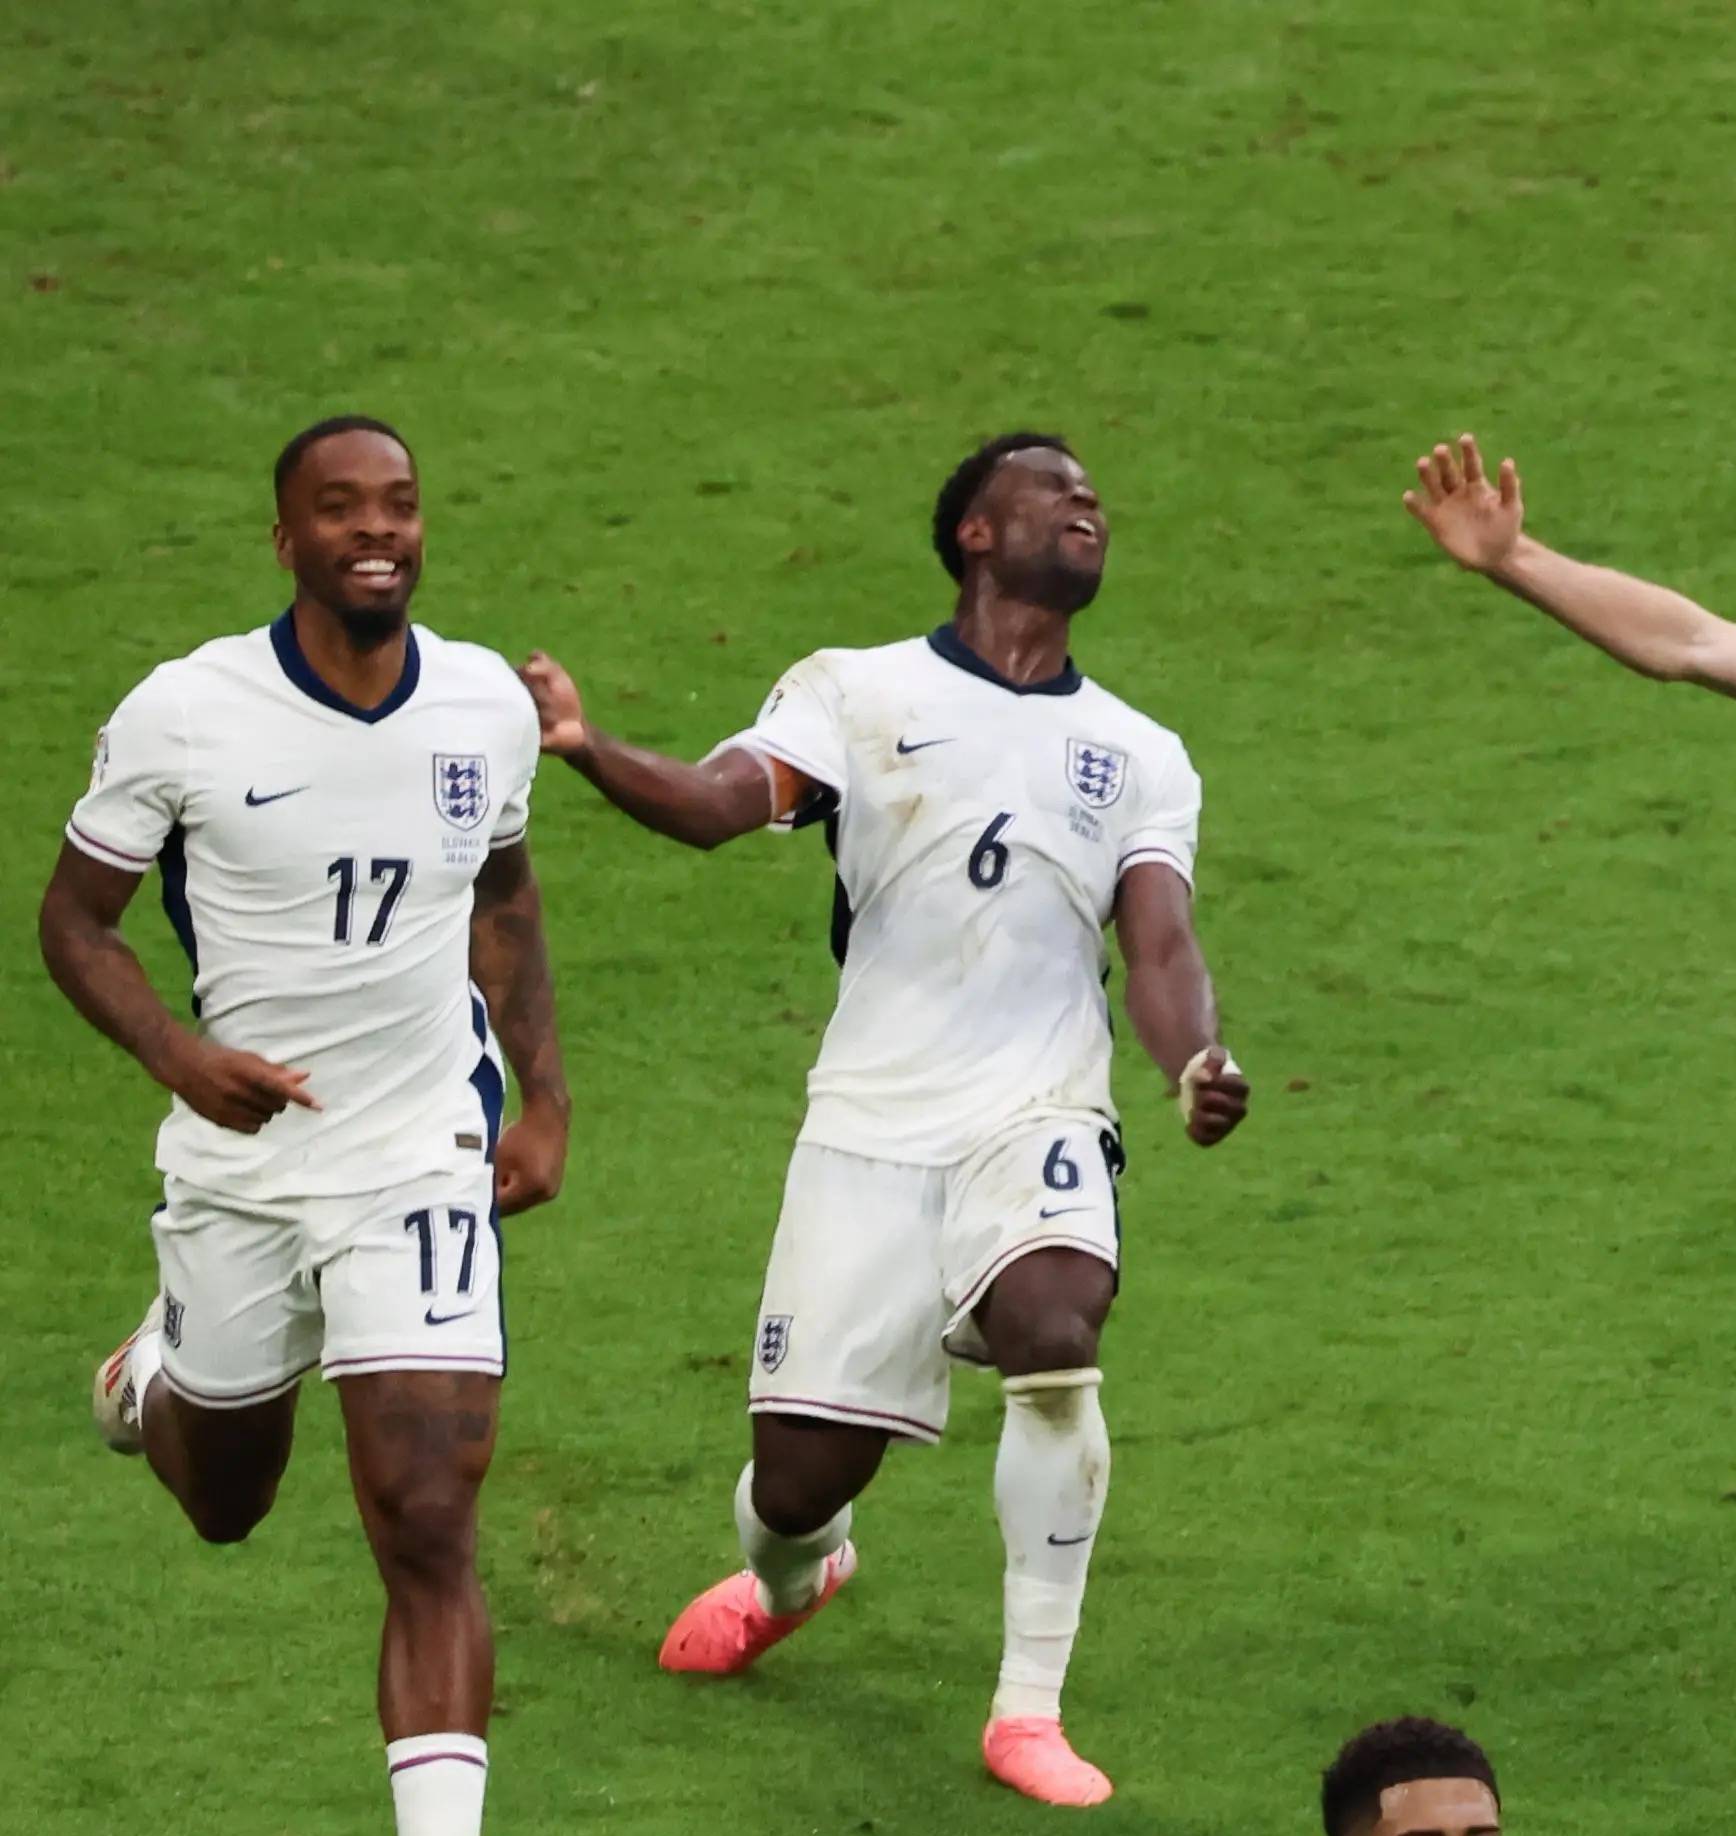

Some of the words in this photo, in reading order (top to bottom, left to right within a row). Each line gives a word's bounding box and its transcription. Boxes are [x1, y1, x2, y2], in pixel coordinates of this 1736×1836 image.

[968, 811, 1015, 890] 6
[327, 856, 413, 946] 17
[1043, 1137, 1082, 1191] 6
[404, 1207, 478, 1296] 17
